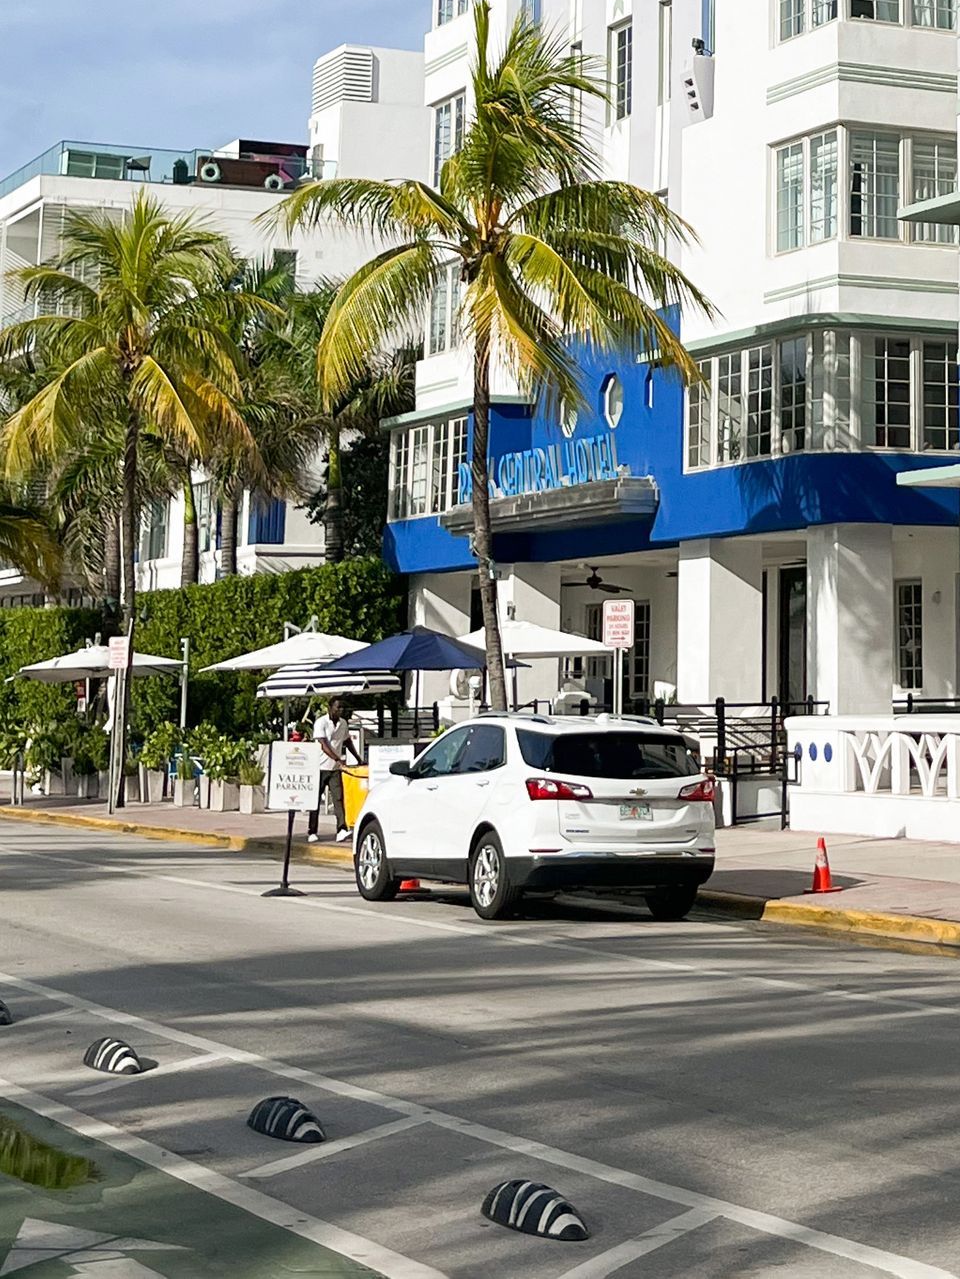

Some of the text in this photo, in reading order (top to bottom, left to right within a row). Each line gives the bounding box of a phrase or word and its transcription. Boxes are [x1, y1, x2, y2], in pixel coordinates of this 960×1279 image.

[498, 443, 562, 496] CENTRAL
[565, 433, 619, 487] HOTEL
[278, 774, 313, 784] VALET
[275, 783, 314, 791] PARKING
